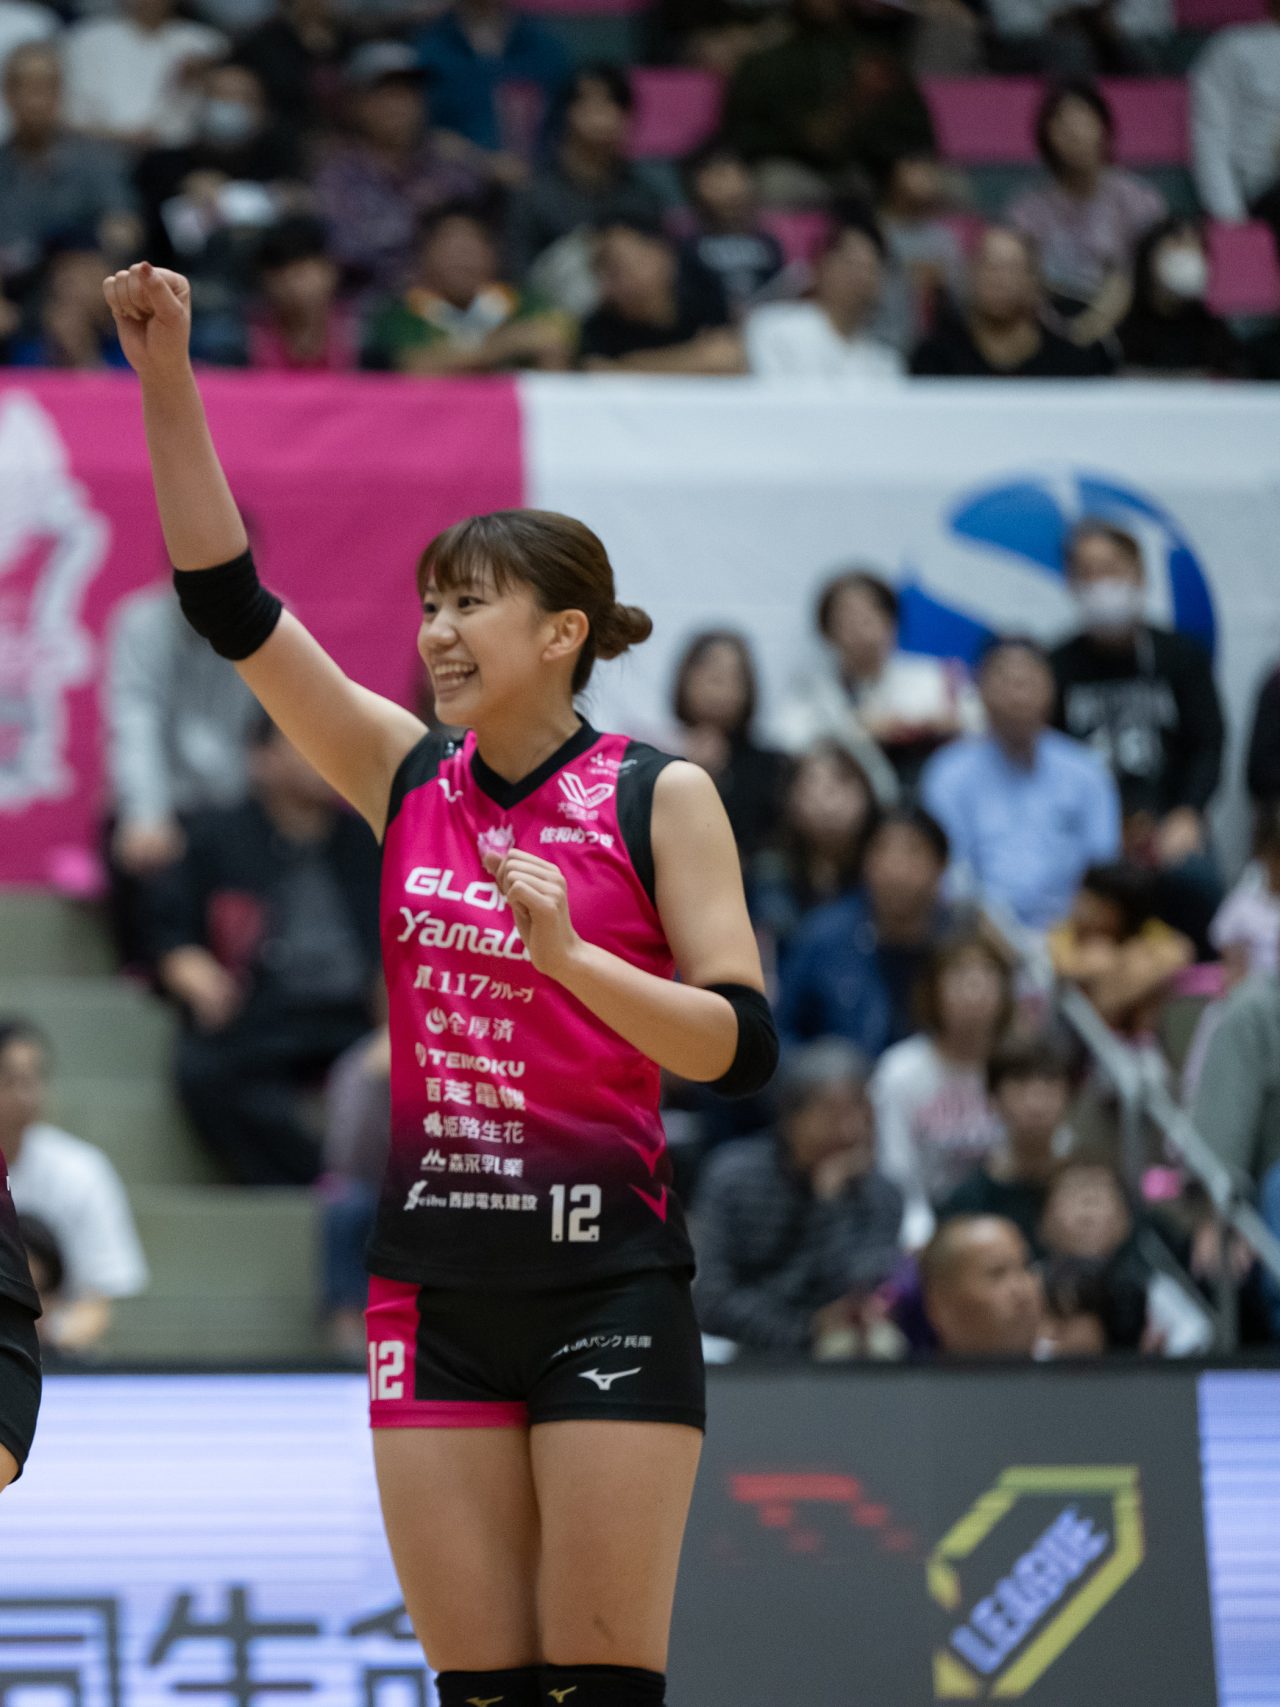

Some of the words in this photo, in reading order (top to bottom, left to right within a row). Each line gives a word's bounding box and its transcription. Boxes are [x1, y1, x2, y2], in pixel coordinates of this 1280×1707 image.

[449, 1191, 539, 1211] 西部電気建設
[549, 1184, 602, 1242] 12
[368, 1340, 405, 1401] 12
